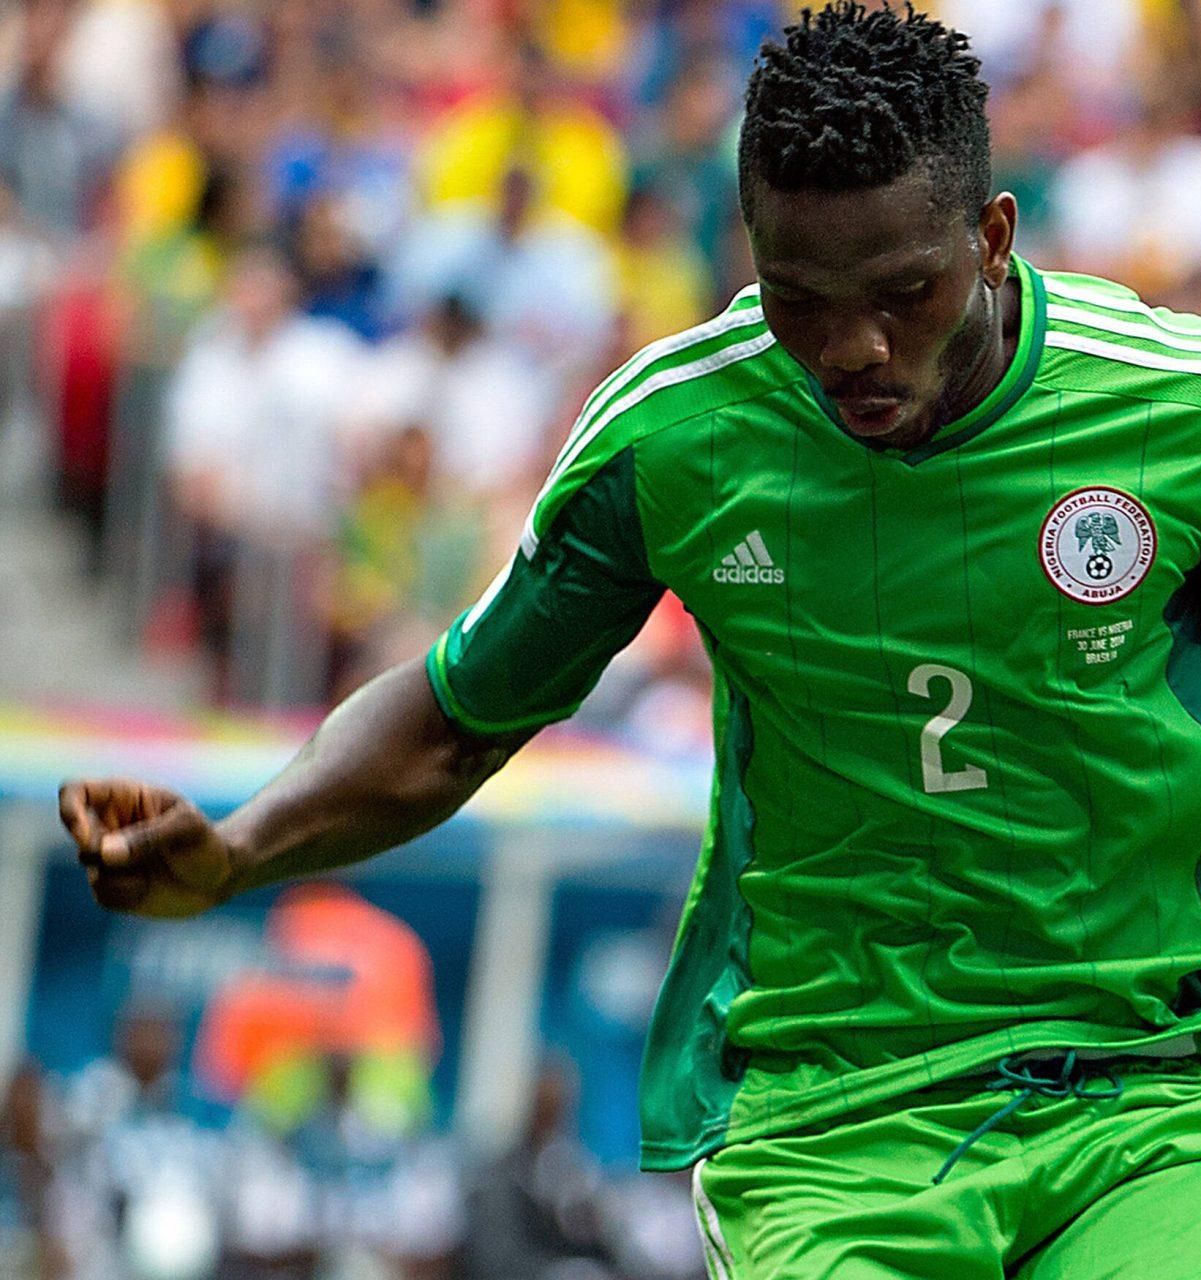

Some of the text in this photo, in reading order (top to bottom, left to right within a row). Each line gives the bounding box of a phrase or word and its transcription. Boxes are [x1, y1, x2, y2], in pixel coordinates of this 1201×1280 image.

[1045, 495, 1152, 579] NIGERIA FOOTBALL FEDERATION
[713, 564, 785, 584] adidas
[1082, 585, 1123, 598] ABUJA
[1067, 627, 1096, 640] FRANCE
[1077, 640, 1088, 651] 30
[1089, 638, 1107, 651] JUNE
[907, 663, 988, 793] 2
